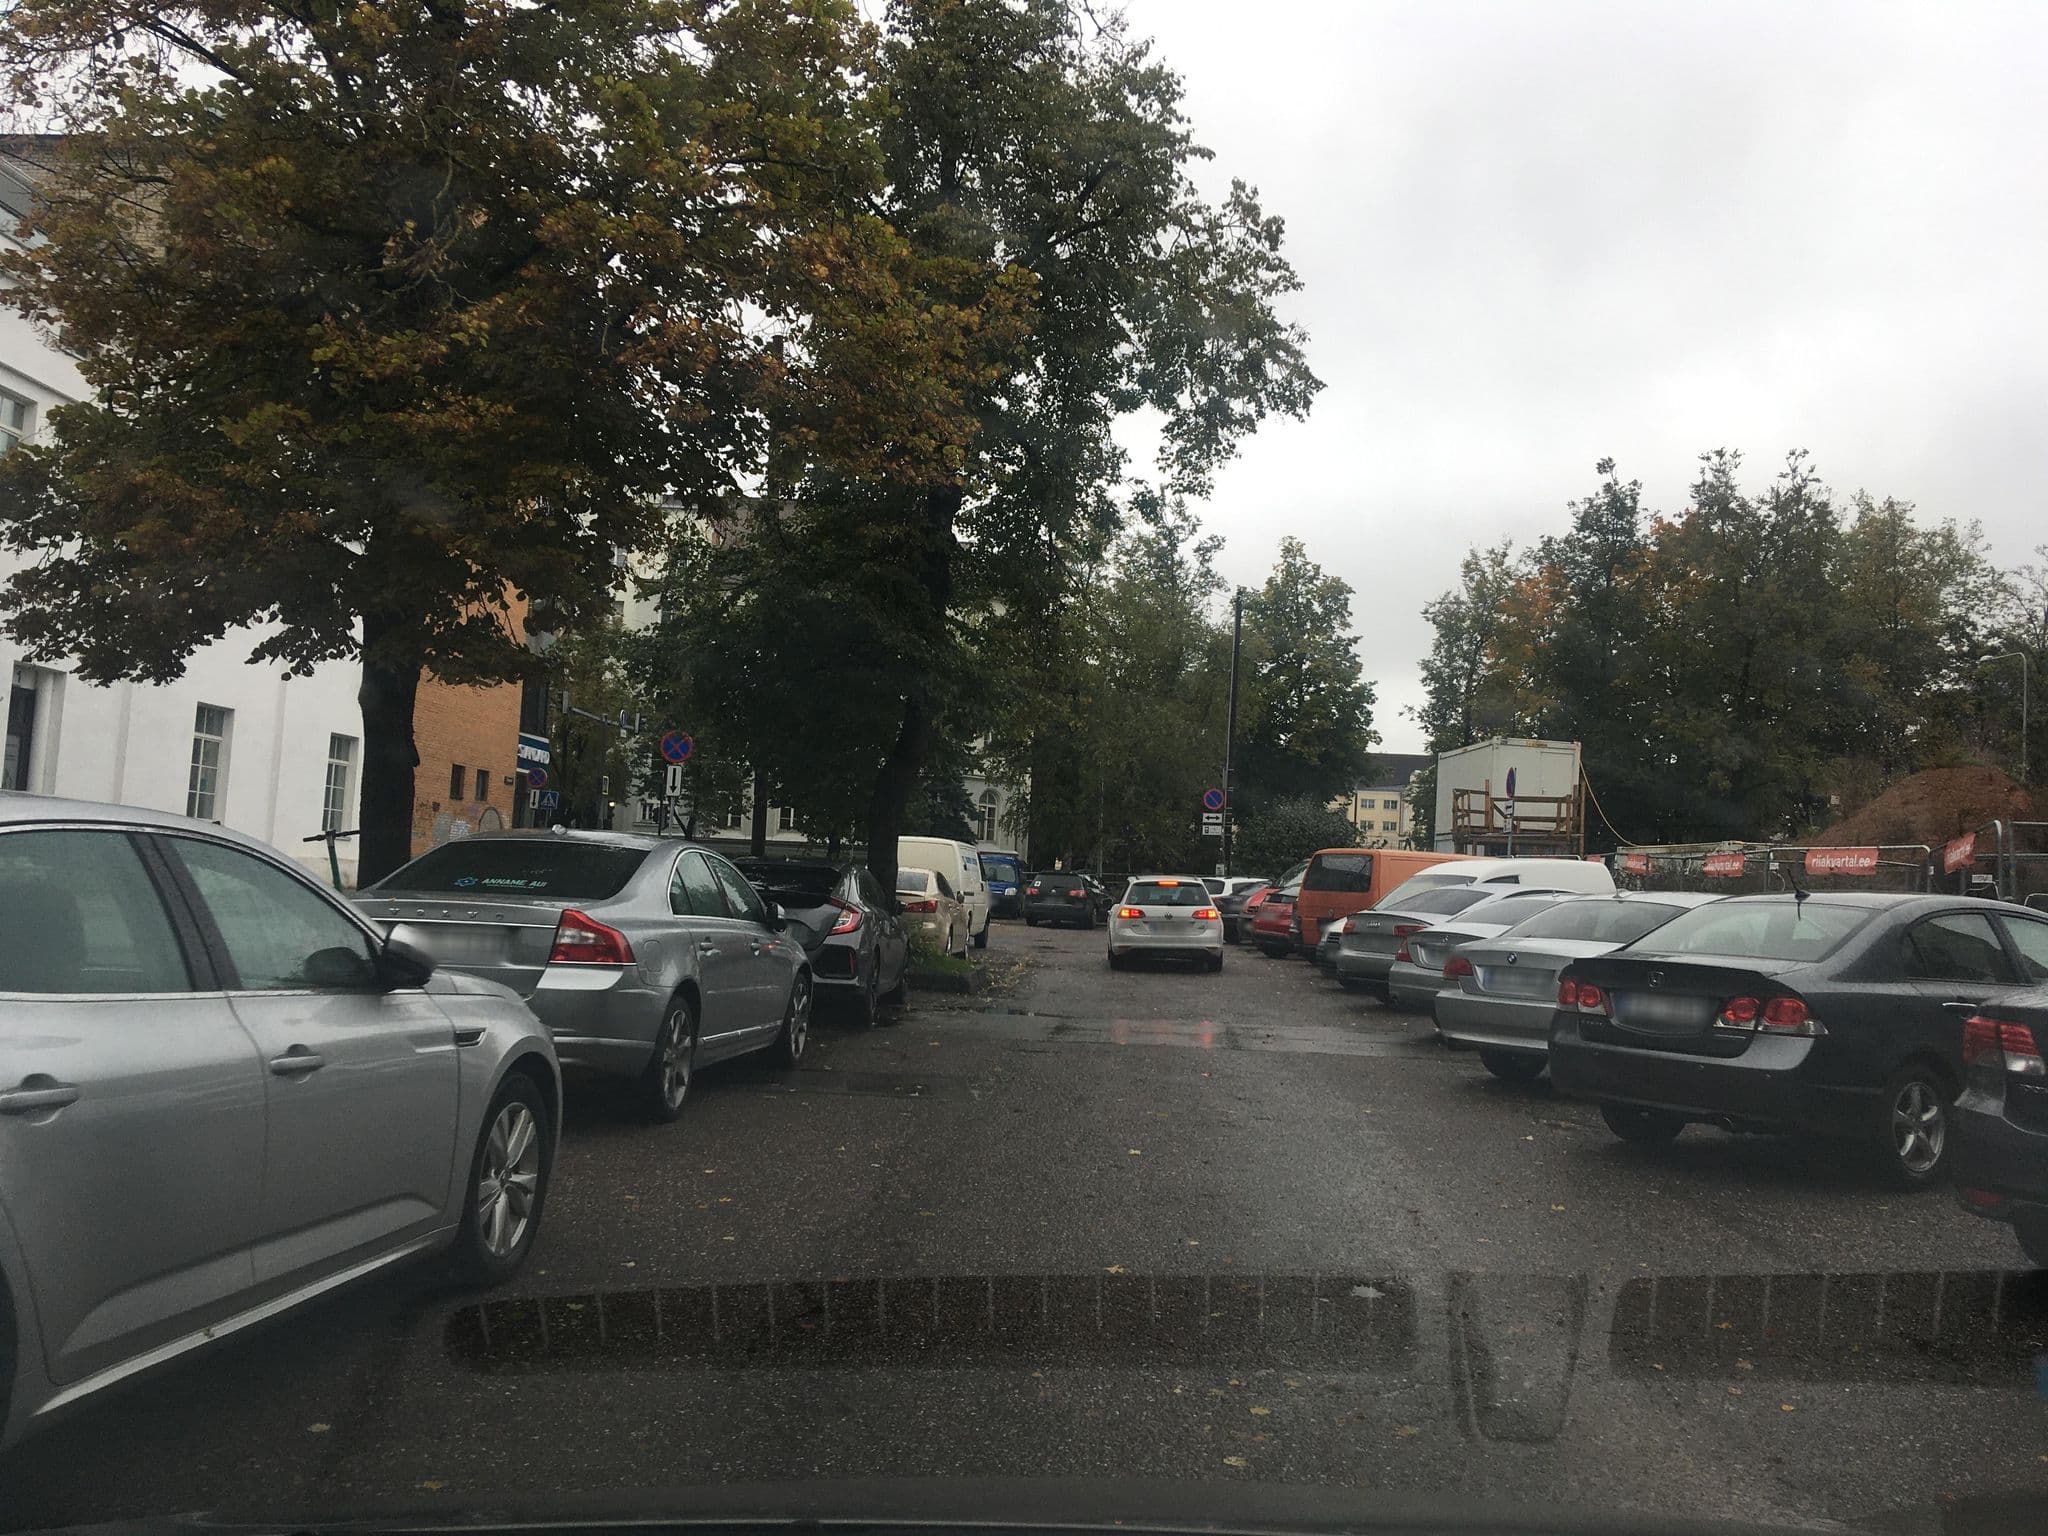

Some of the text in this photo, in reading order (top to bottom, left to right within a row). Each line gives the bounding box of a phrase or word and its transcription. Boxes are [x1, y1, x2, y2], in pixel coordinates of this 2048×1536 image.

[1811, 854, 1871, 868] riiakvartal.ee
[481, 878, 528, 886] ANNAME
[388, 906, 504, 921] VOLVO
